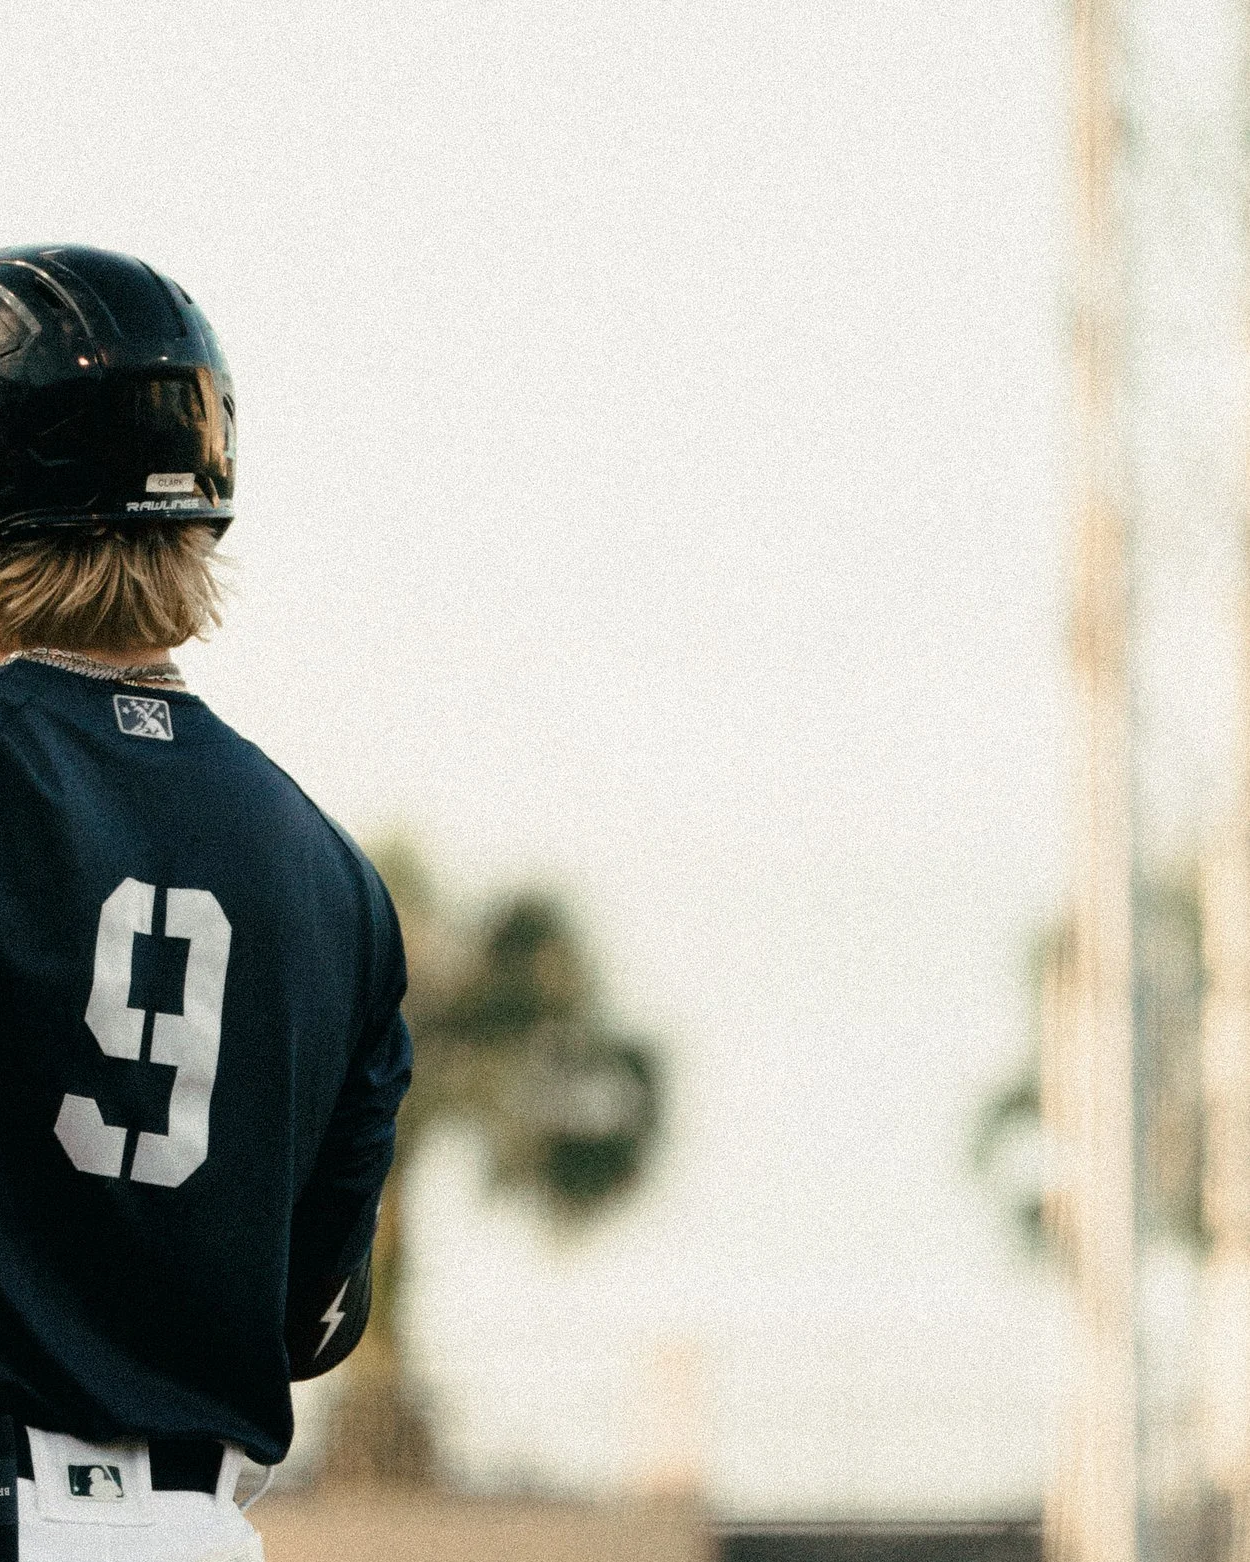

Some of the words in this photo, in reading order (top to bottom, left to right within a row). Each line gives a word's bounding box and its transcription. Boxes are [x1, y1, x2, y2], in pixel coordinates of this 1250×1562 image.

[157, 479, 184, 488] CLARK
[126, 498, 200, 512] RAWLINGS
[53, 876, 232, 1188] 9
